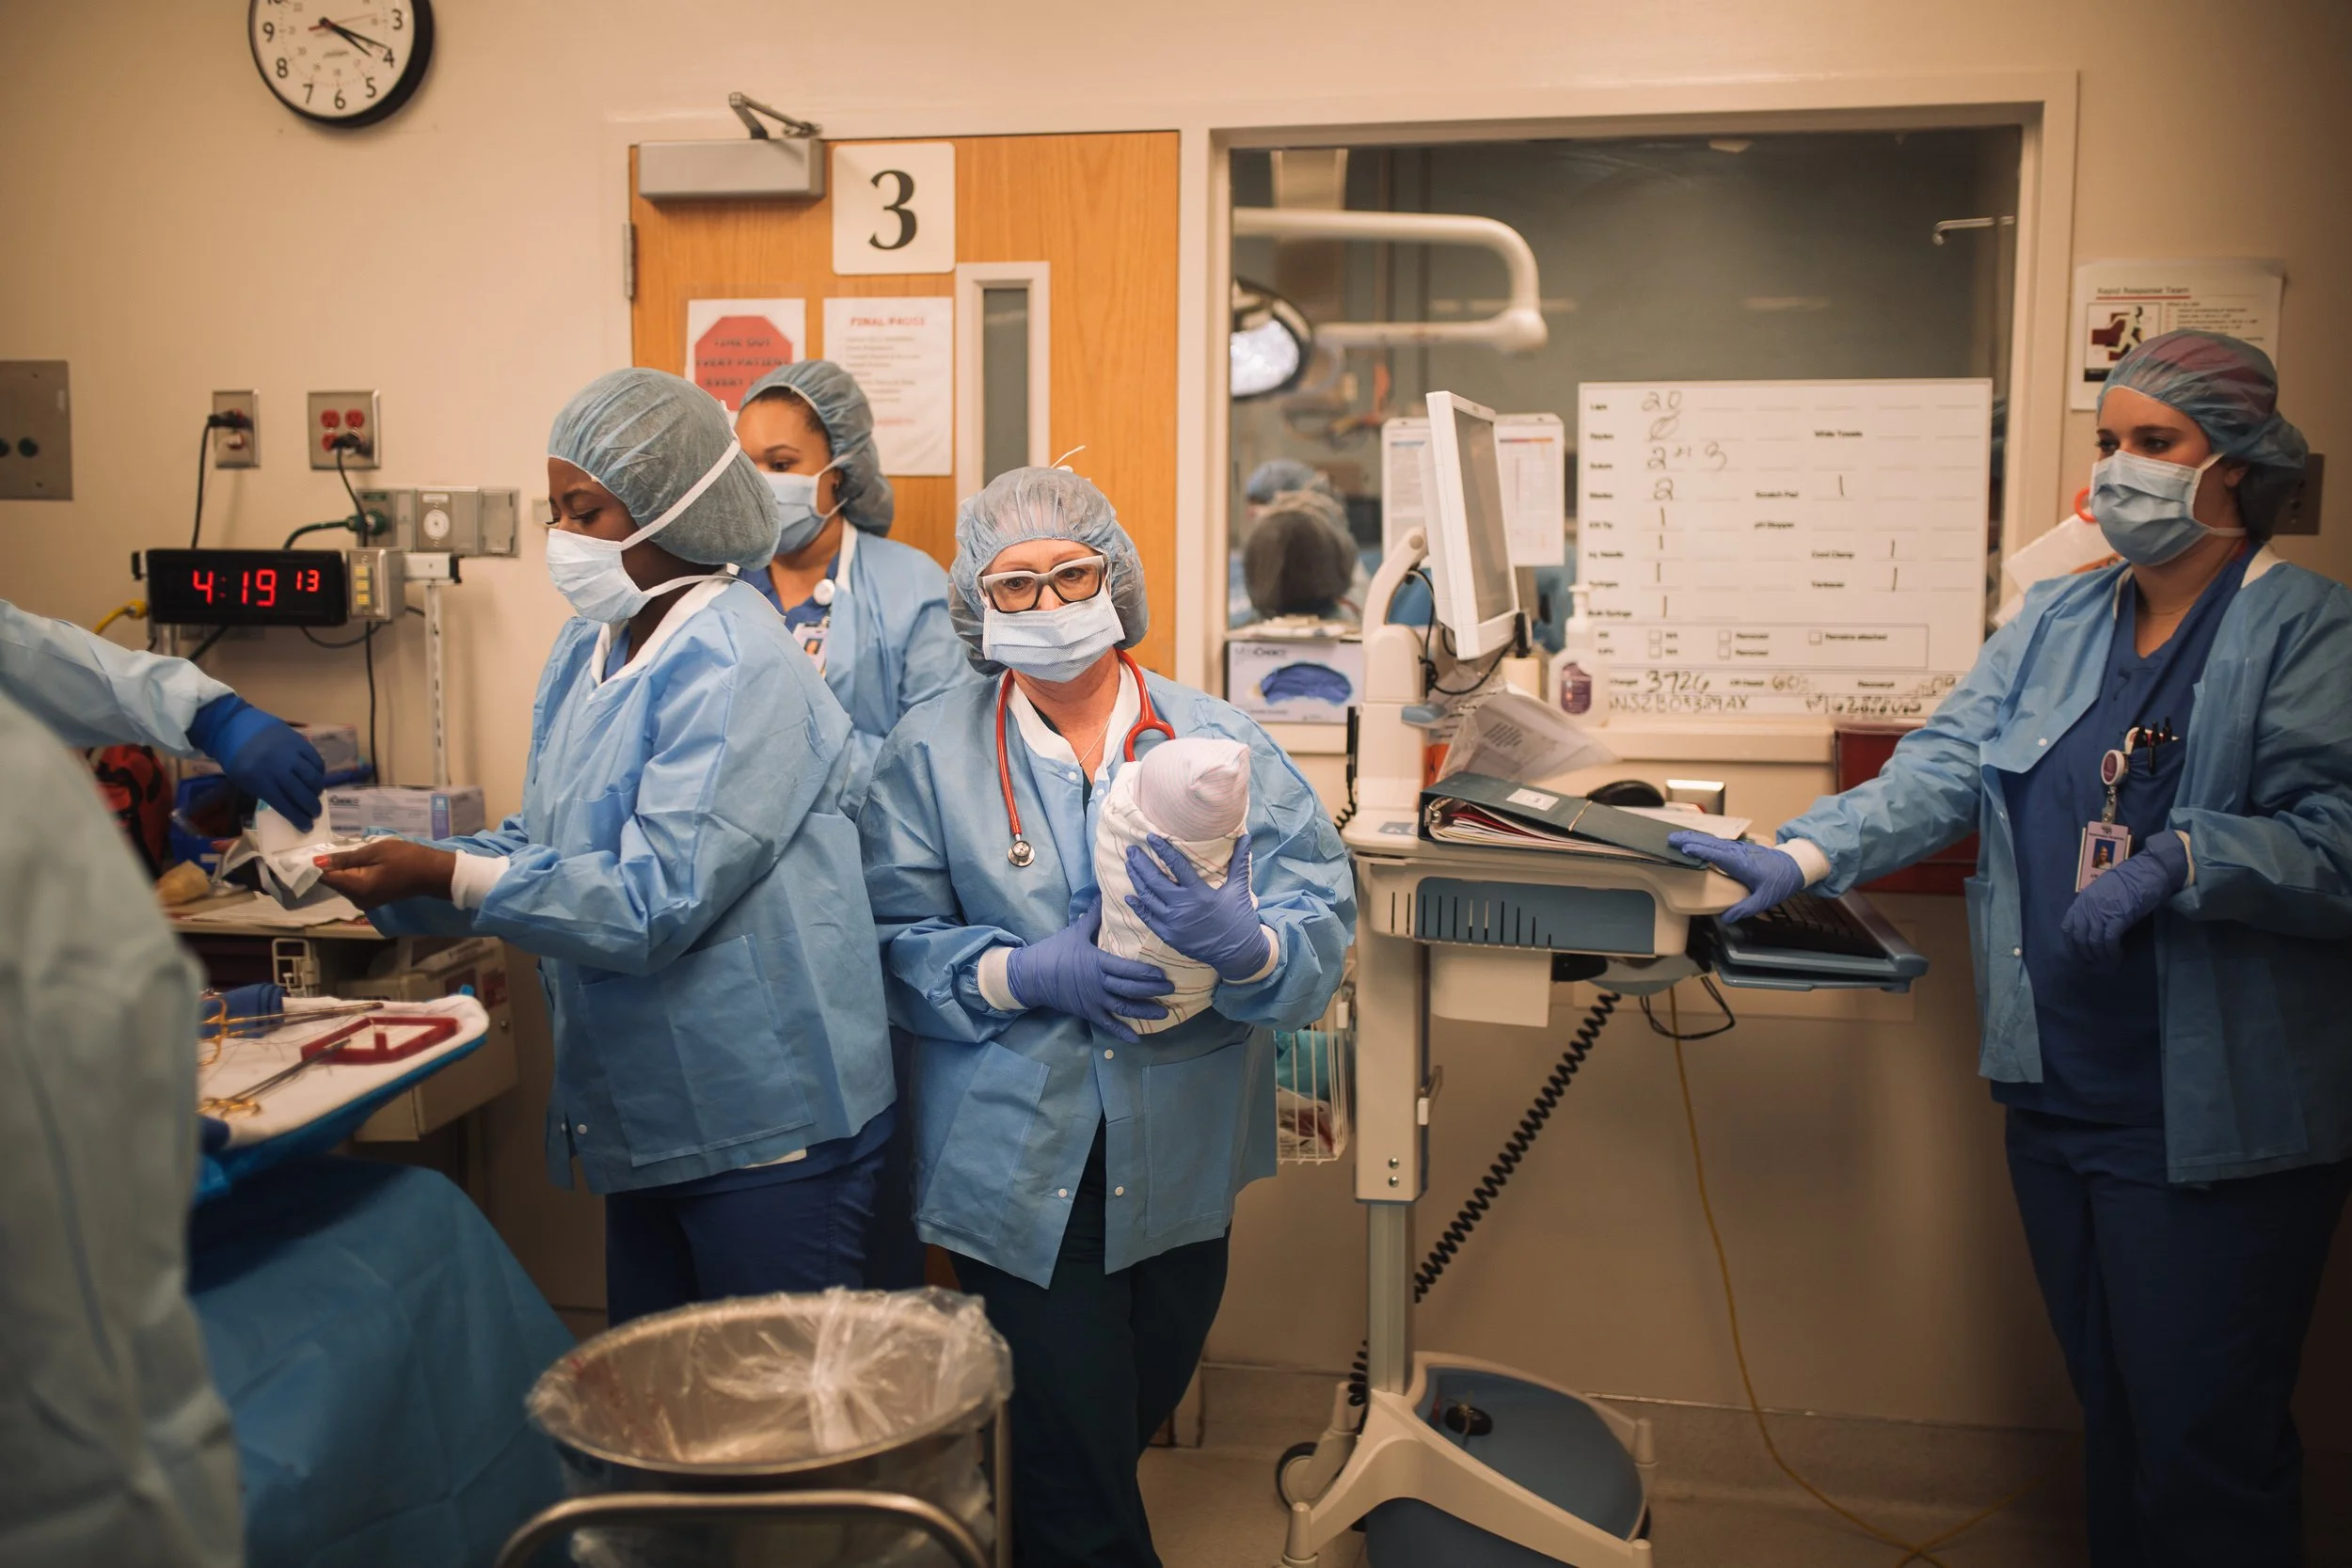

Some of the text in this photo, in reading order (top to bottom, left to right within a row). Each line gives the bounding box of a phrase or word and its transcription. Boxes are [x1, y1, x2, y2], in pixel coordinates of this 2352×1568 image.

[391, 8, 404, 30] 3
[262, 22, 275, 42] 9
[276, 57, 289, 78] 8
[382, 48, 395, 69] 4
[302, 83, 314, 104] 7
[365, 77, 377, 98] 5
[334, 89, 346, 110] 6
[868, 168, 918, 251] 3
[2123, 286, 2163, 295] Response
[2166, 286, 2190, 294] Team
[1641, 389, 1682, 412] 20
[1653, 476, 1674, 500] 2
[192, 568, 321, 607] 4:19 13
